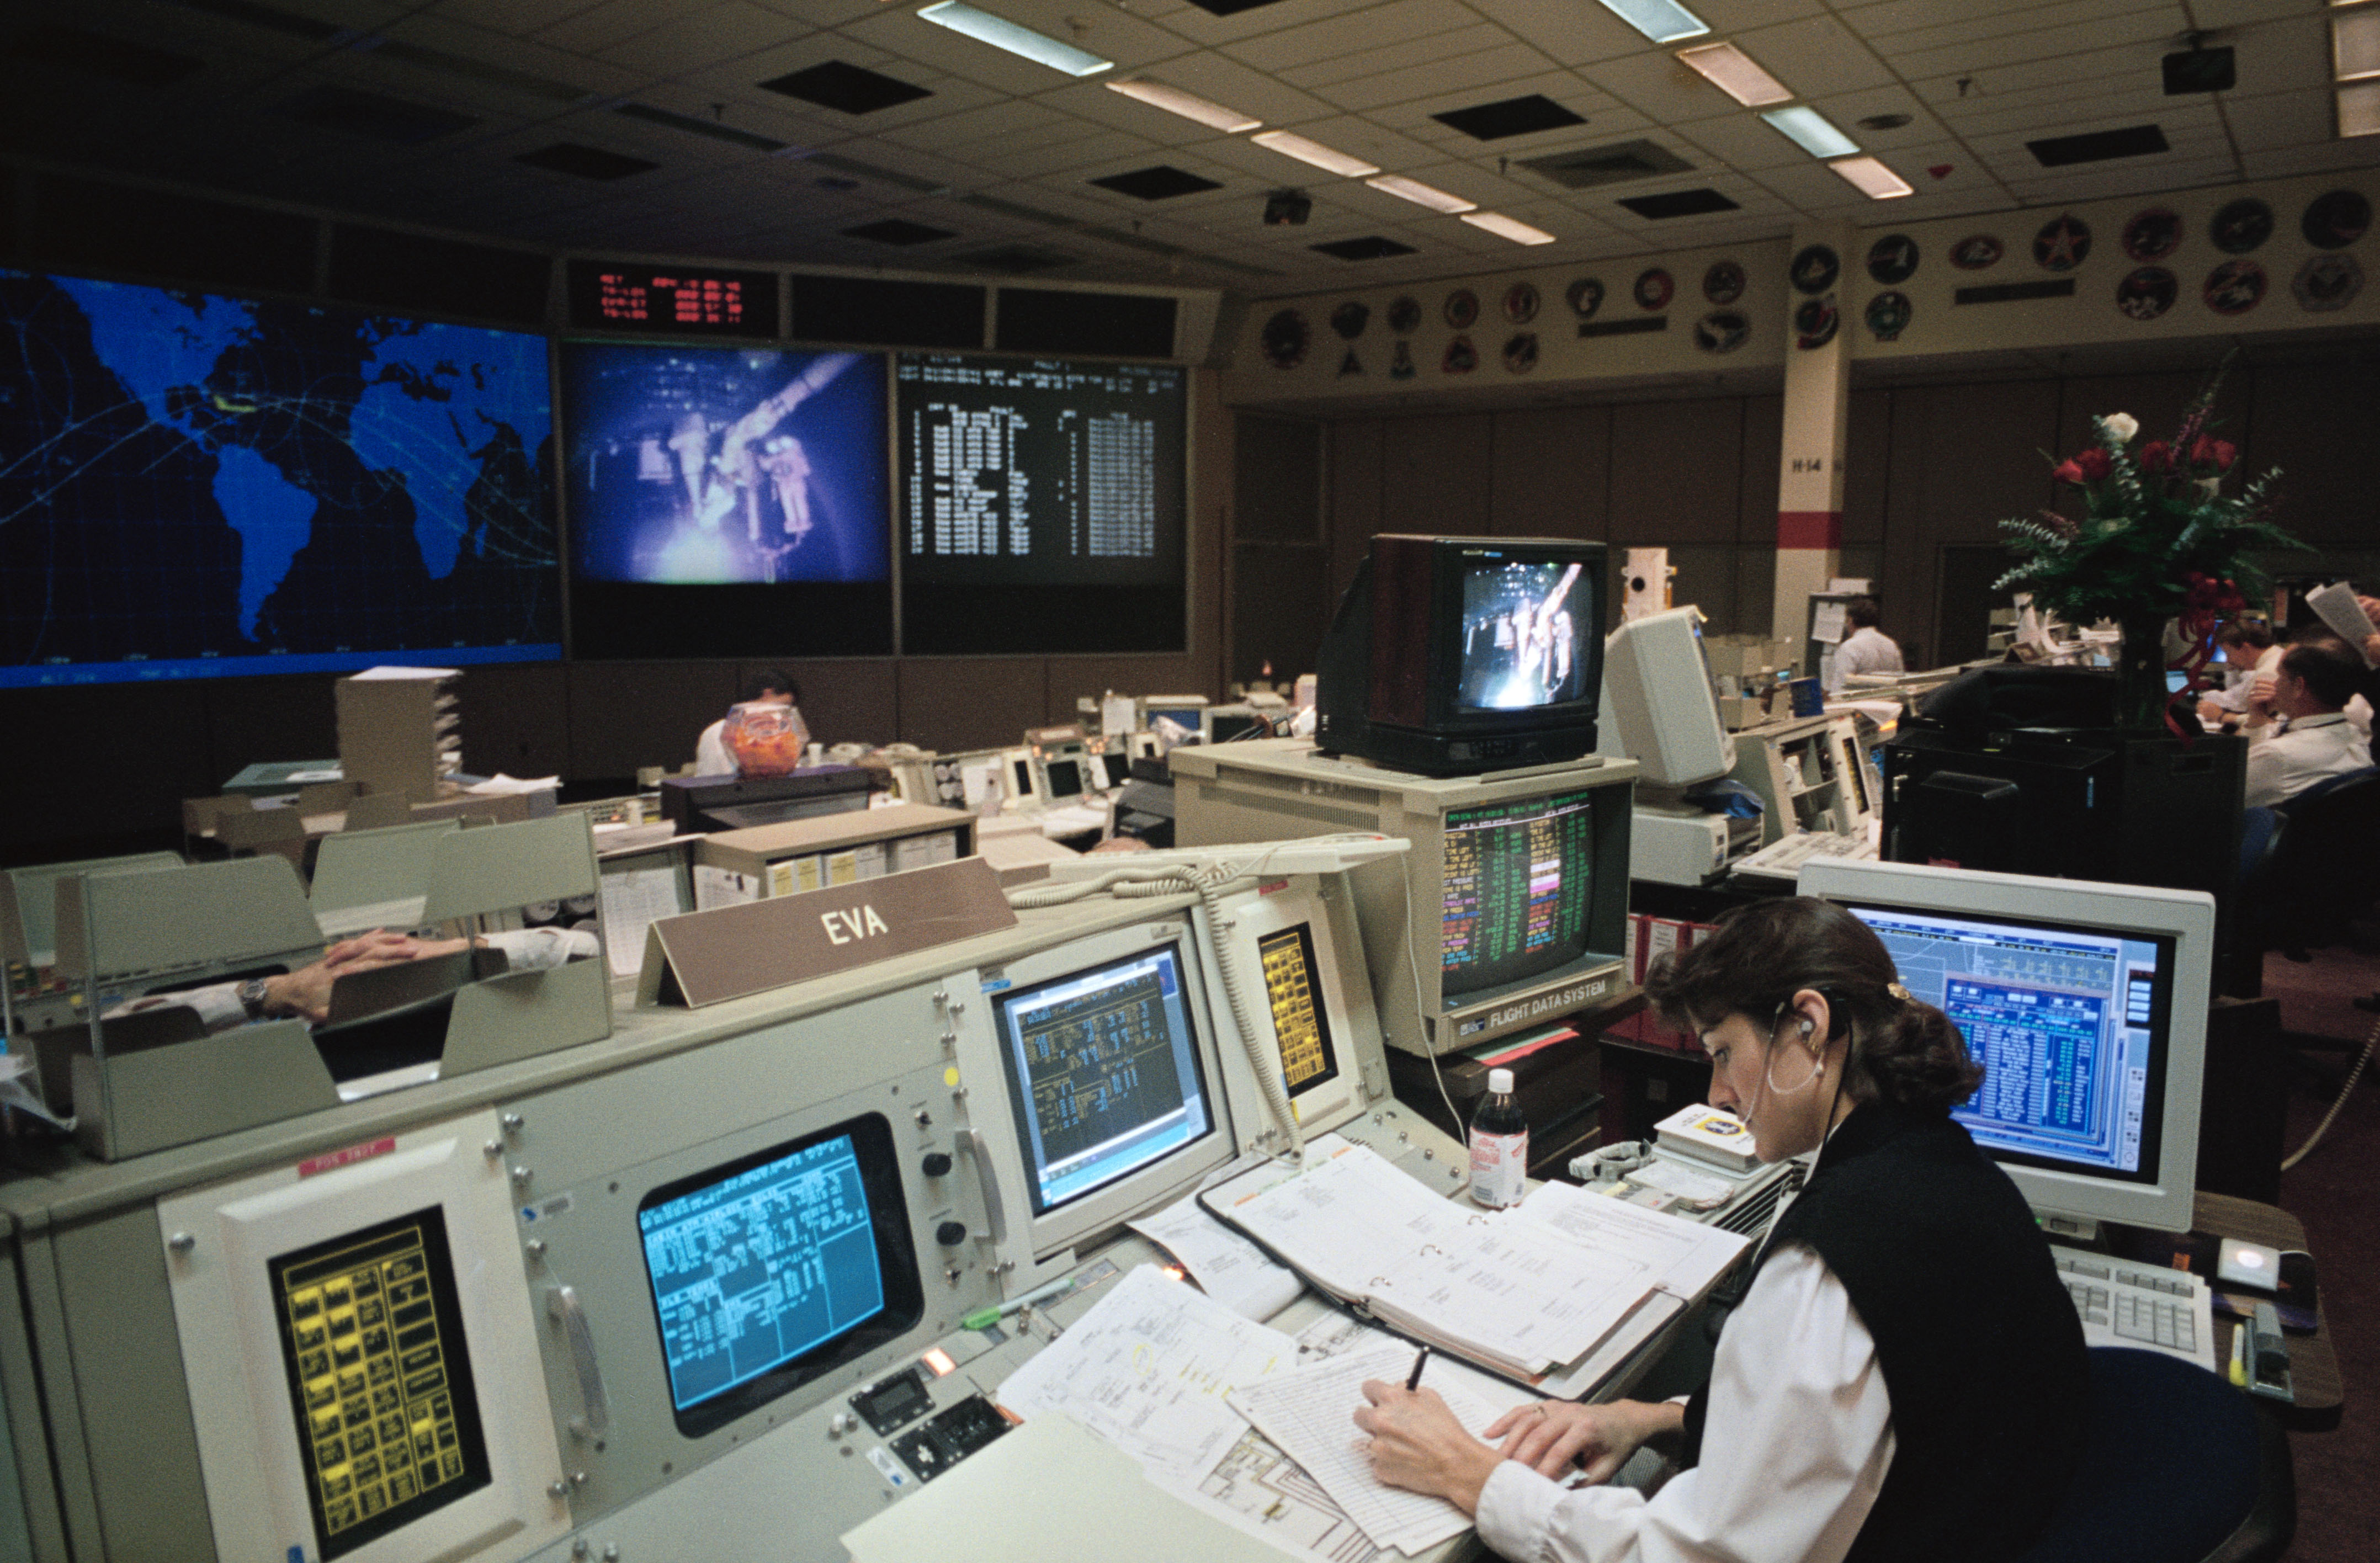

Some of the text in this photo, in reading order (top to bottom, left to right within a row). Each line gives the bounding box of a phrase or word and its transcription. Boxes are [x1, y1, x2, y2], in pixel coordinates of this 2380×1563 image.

[821, 905, 888, 944] EVA
[1491, 980, 1606, 1027] FLIGHT DATA SYSTEM
